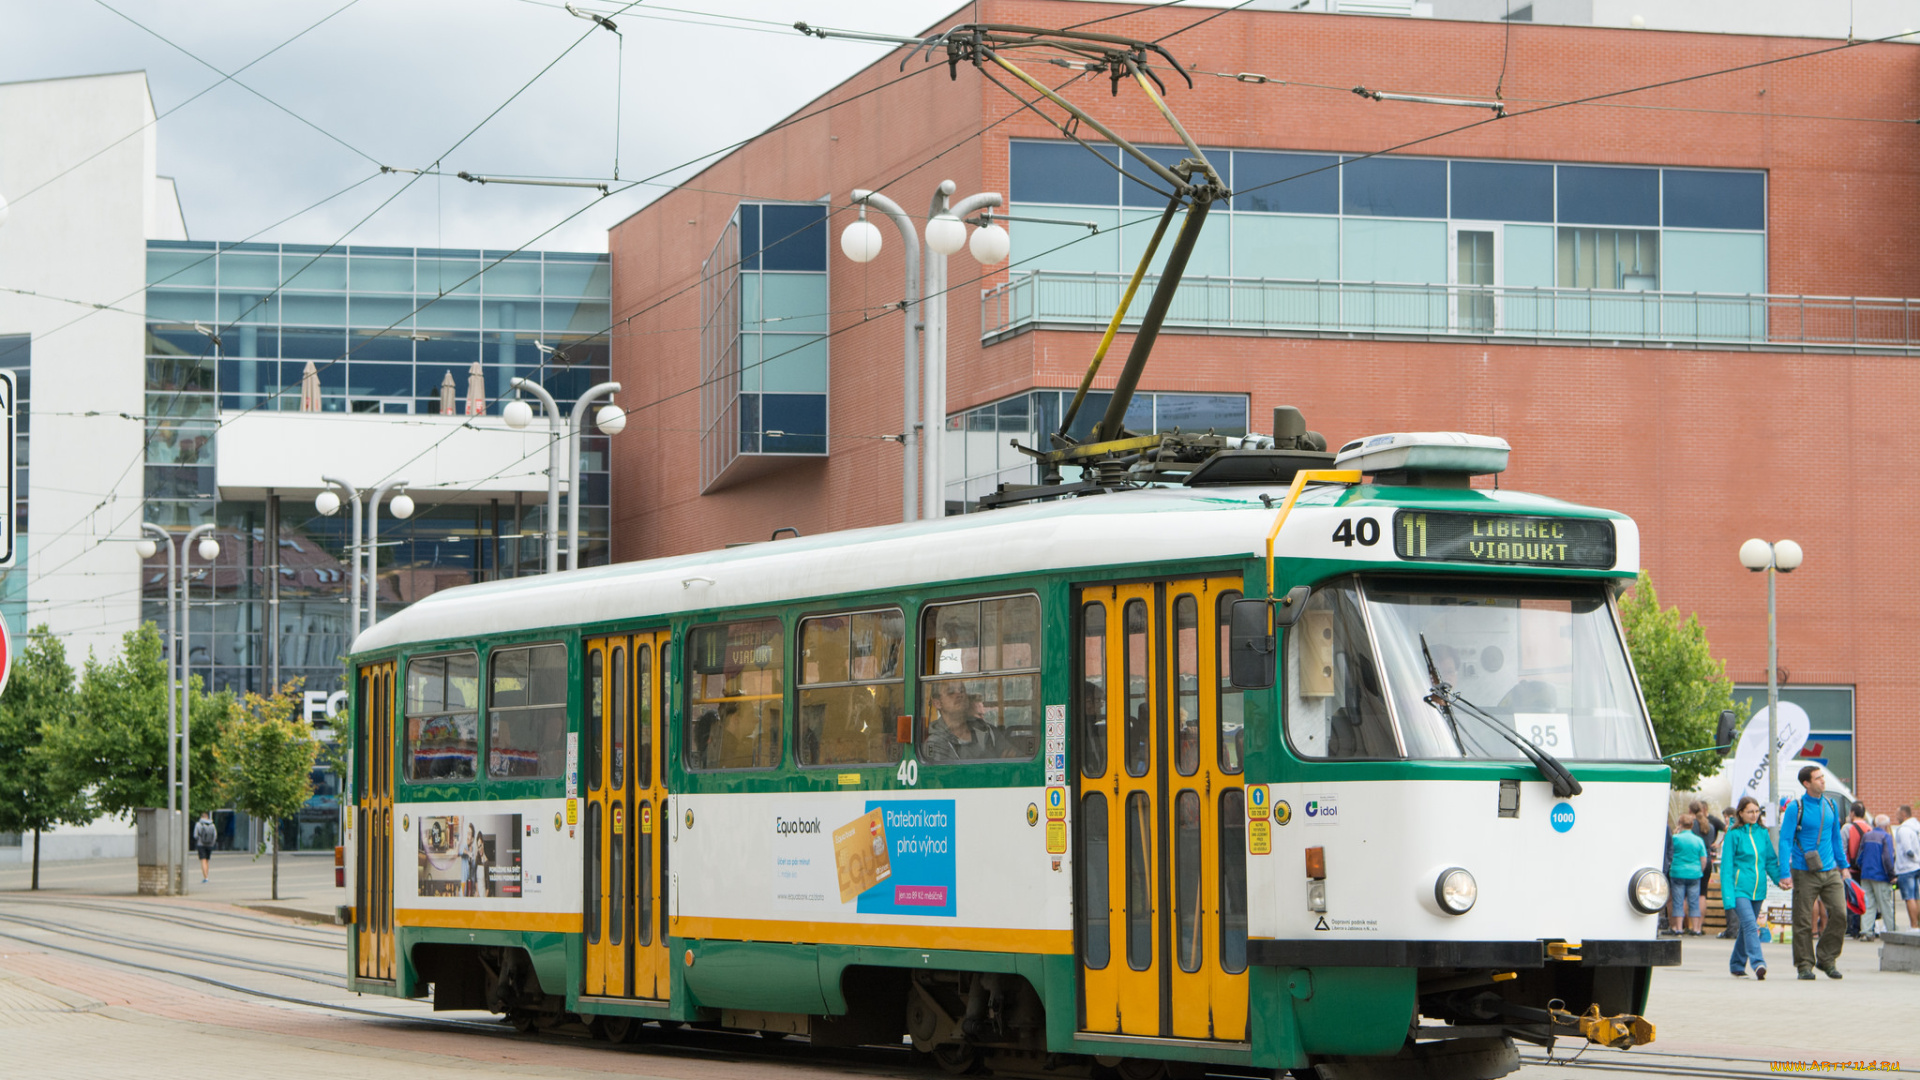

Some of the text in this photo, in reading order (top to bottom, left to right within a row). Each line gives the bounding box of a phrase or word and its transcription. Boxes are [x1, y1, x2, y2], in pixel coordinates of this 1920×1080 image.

[1332, 517, 1380, 547] 40
[1403, 513, 1427, 557] 11
[1473, 520, 1564, 539] LIBEREC
[1470, 541, 1568, 561] VIADUKT
[732, 648, 774, 665] VIADUKT
[1531, 725, 1558, 747] 85
[897, 759, 918, 786] 40
[887, 809, 922, 828] Platební
[924, 810, 947, 828] karta
[1320, 805, 1338, 816] idol
[1552, 812, 1574, 823] 1000
[776, 816, 821, 838] Equa bank
[897, 835, 948, 857] plná výhod
